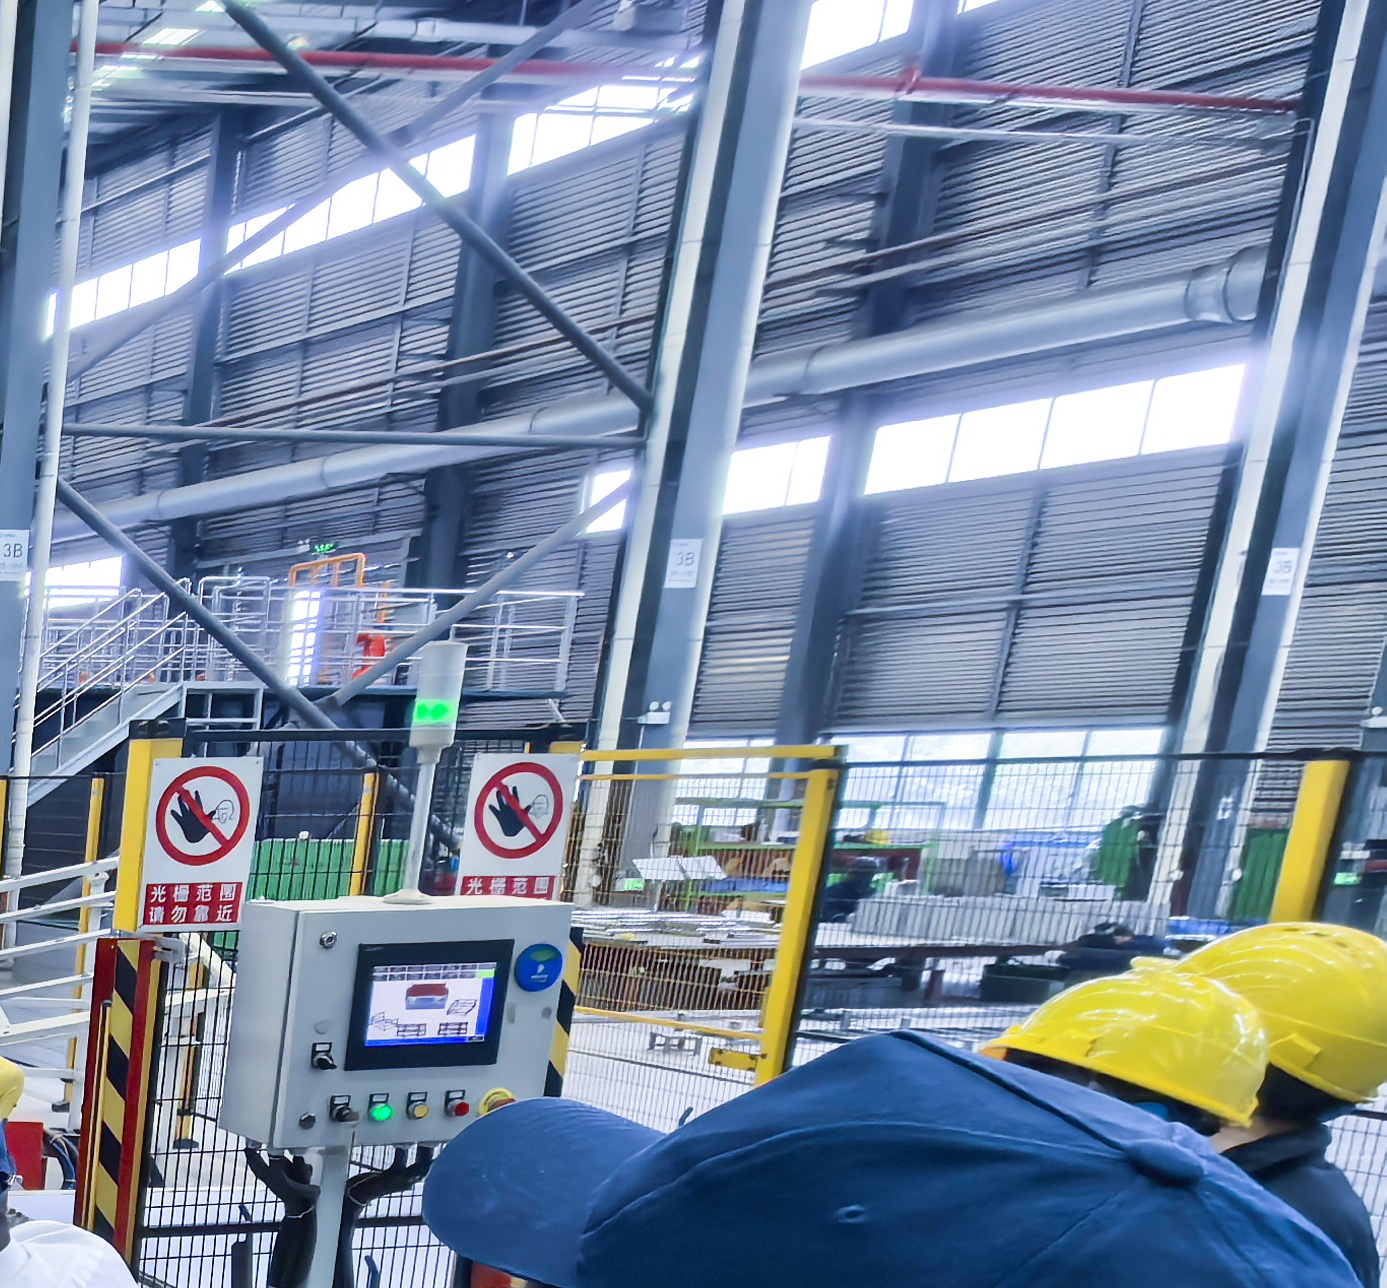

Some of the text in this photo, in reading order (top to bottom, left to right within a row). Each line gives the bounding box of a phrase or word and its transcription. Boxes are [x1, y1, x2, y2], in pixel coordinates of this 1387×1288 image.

[3, 543, 23, 558] 3B
[676, 552, 695, 567] 3B
[150, 883, 237, 903] 光栅范围
[148, 904, 234, 924] 请勿靠近
